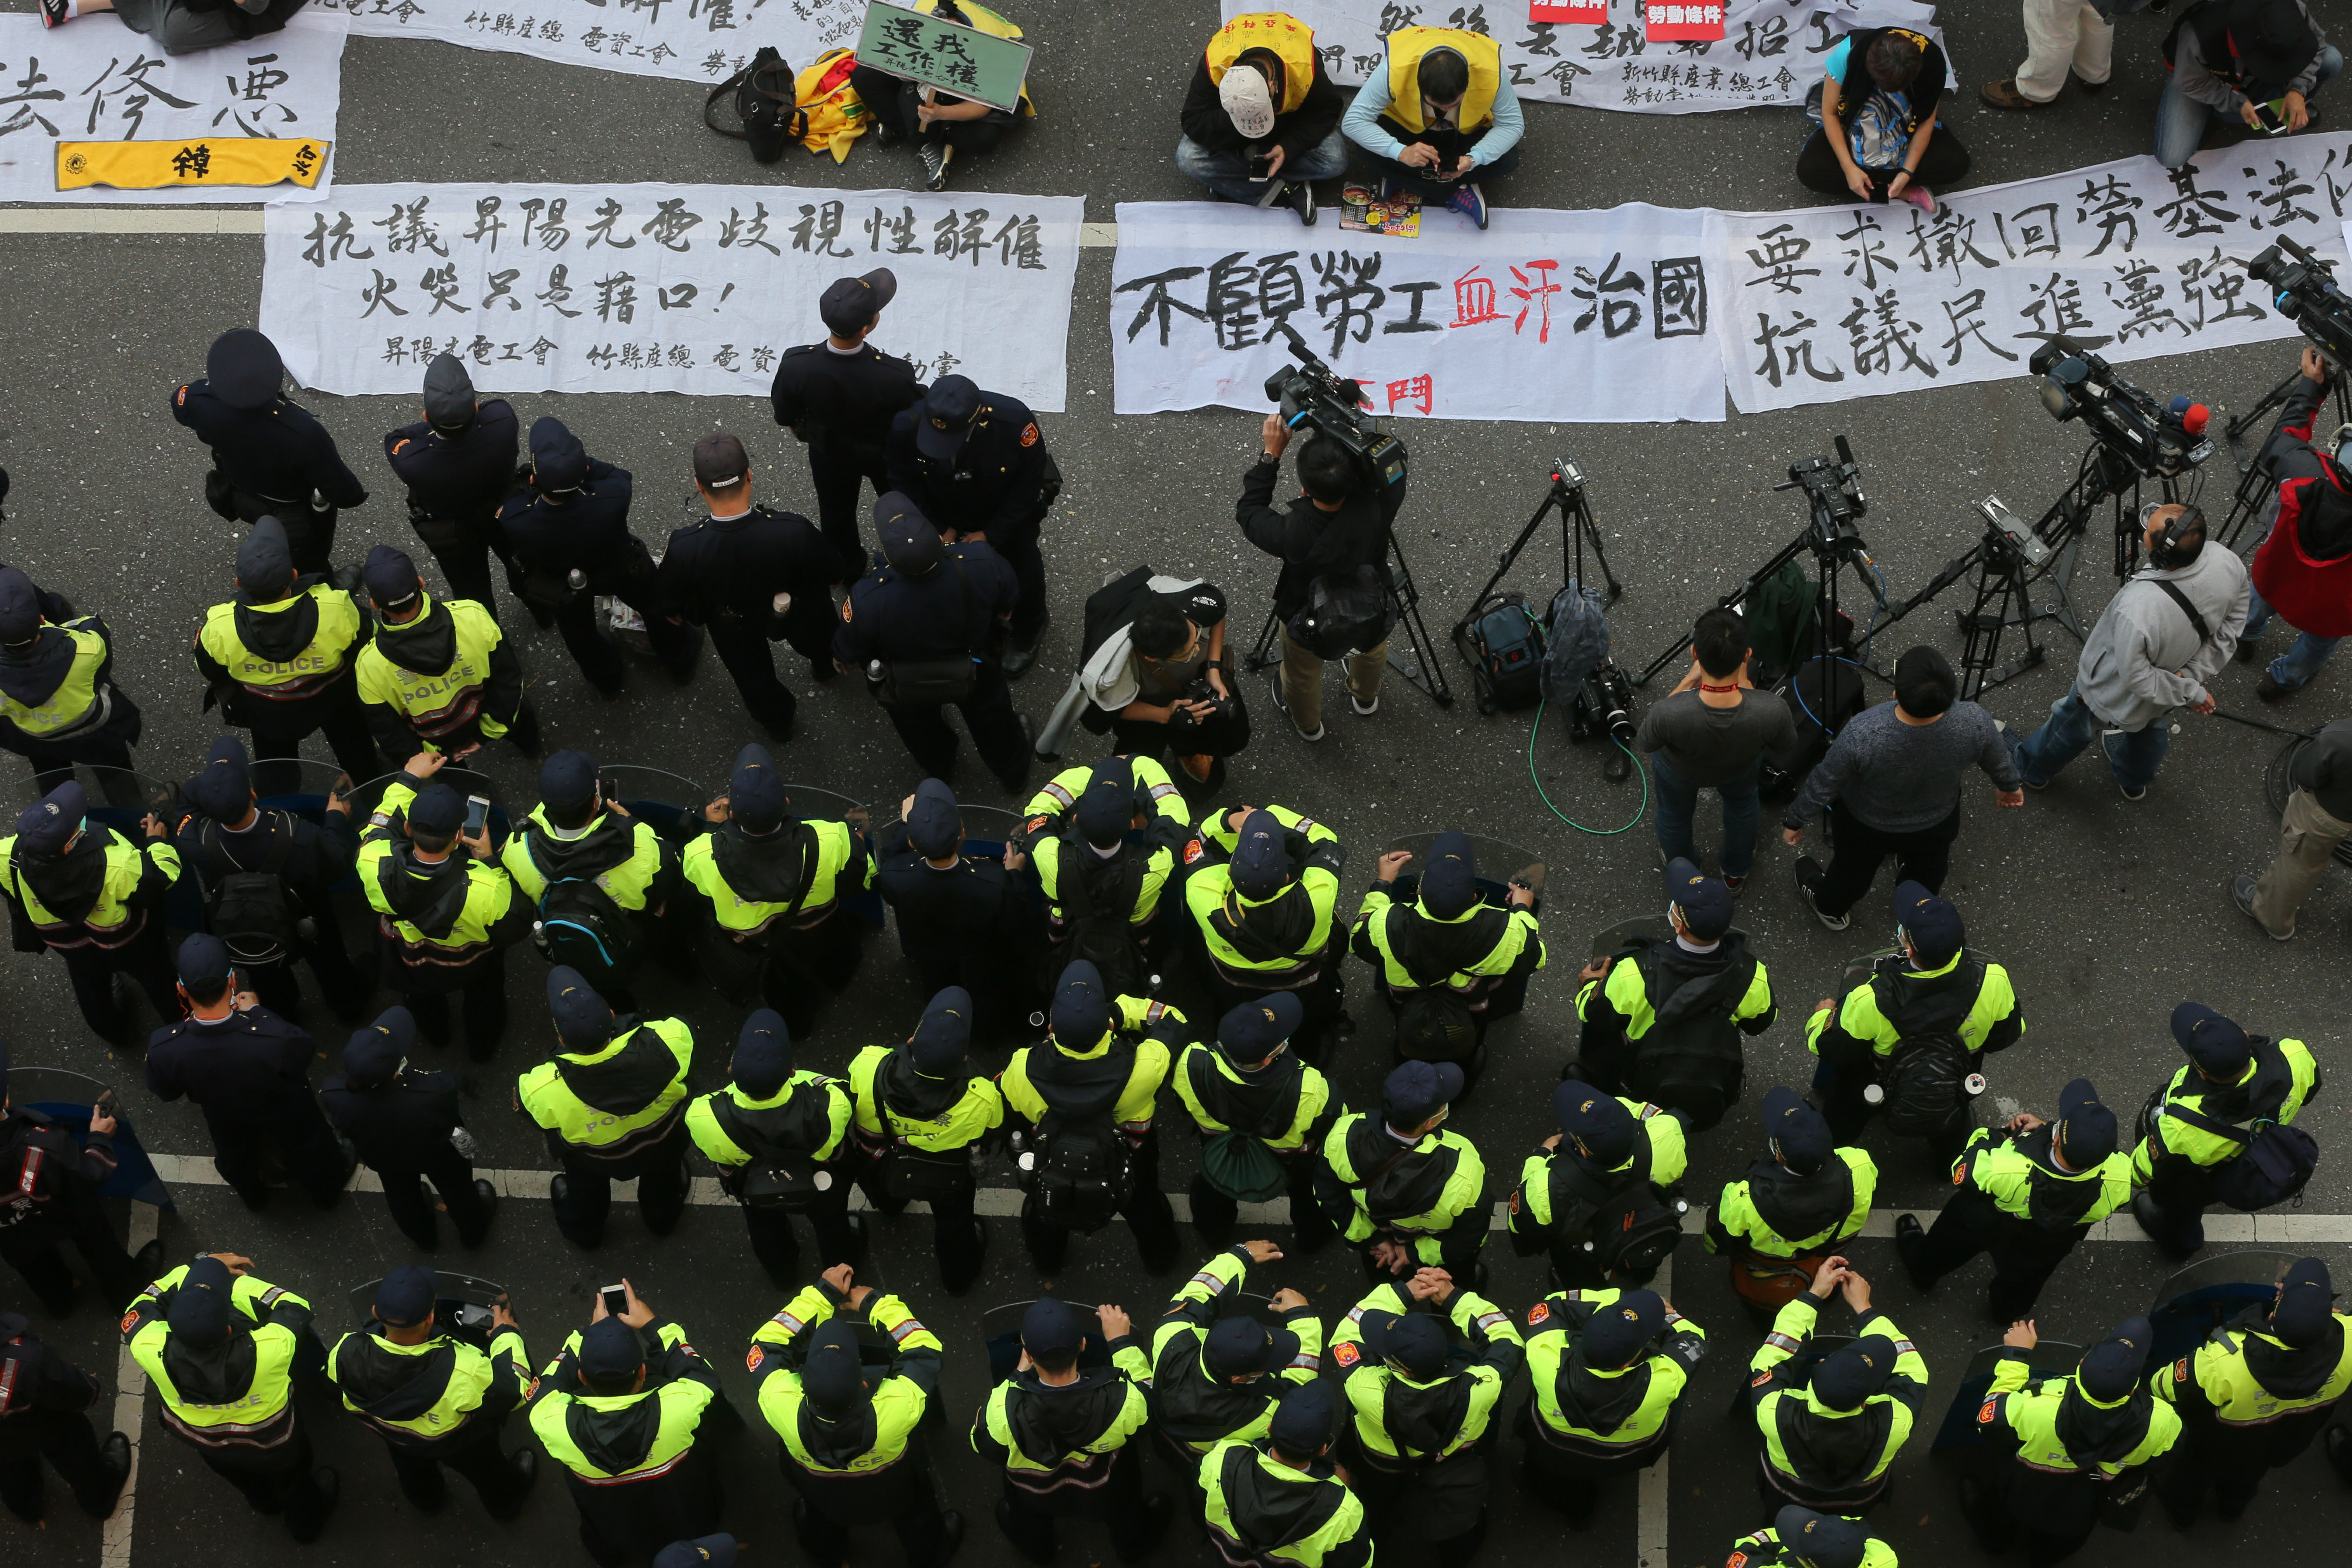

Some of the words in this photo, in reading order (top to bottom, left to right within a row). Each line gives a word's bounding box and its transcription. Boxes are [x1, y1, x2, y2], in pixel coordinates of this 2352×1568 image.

[1648, 5, 1722, 24] 勞動條件
[244, 655, 325, 674] POLICE
[1512, 652, 1519, 661] 6
[404, 665, 475, 705] POLICE
